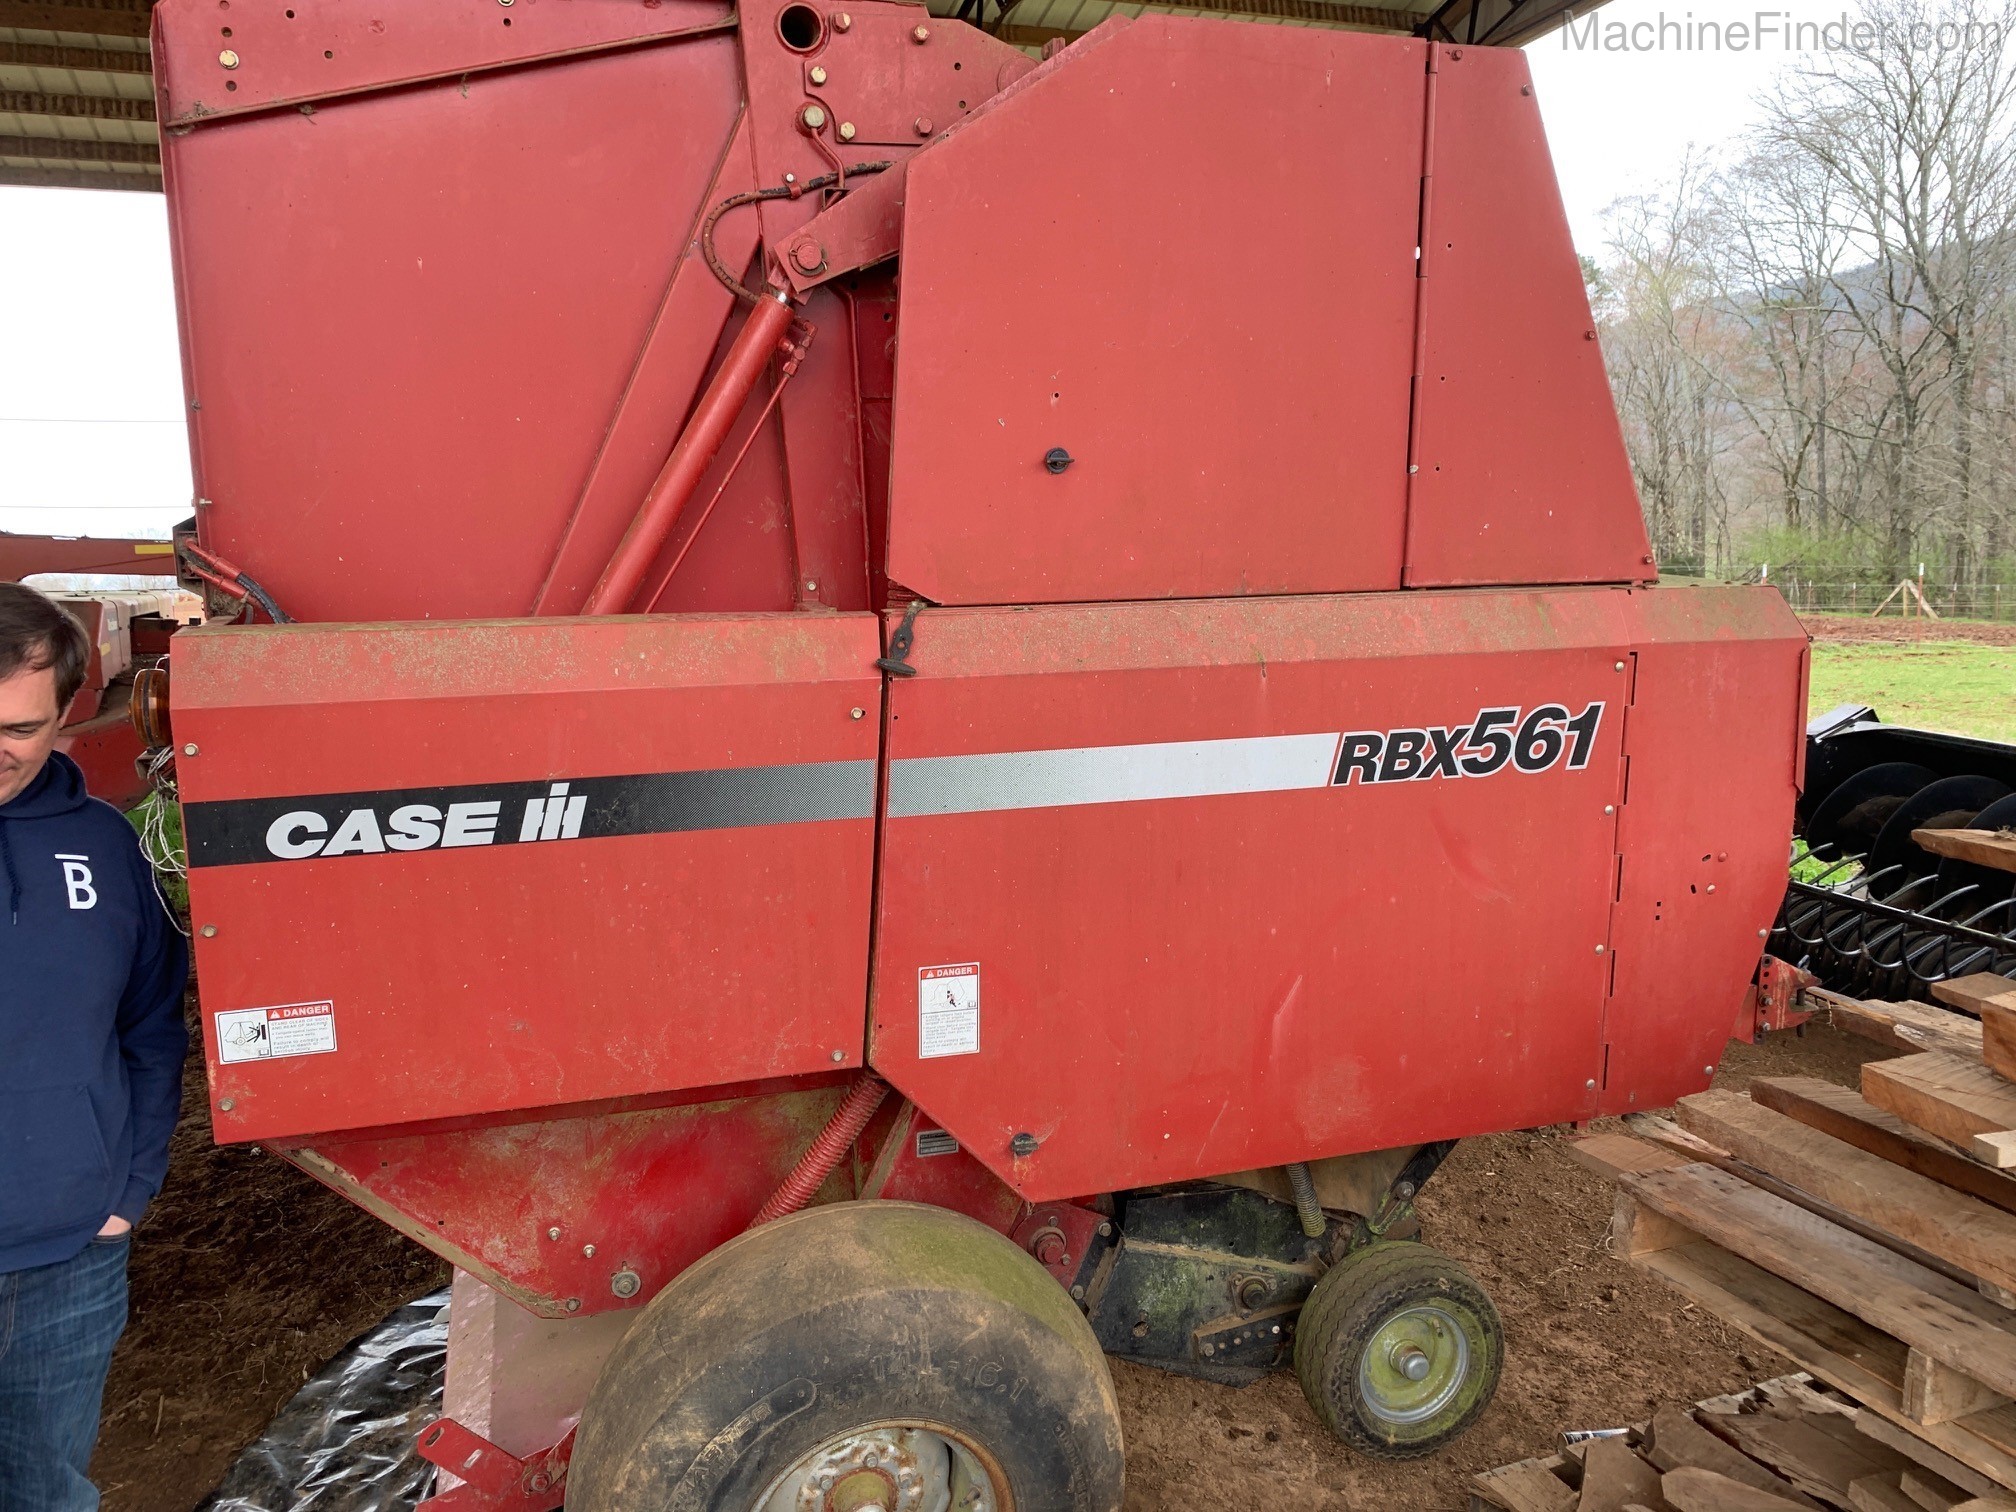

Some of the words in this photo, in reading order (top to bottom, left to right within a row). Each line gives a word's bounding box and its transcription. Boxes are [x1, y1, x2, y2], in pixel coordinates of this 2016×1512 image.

[1331, 702, 1605, 786] RBX561
[265, 801, 501, 859] CASE
[936, 967, 972, 977] DANGER
[284, 1006, 329, 1017] DANGER
